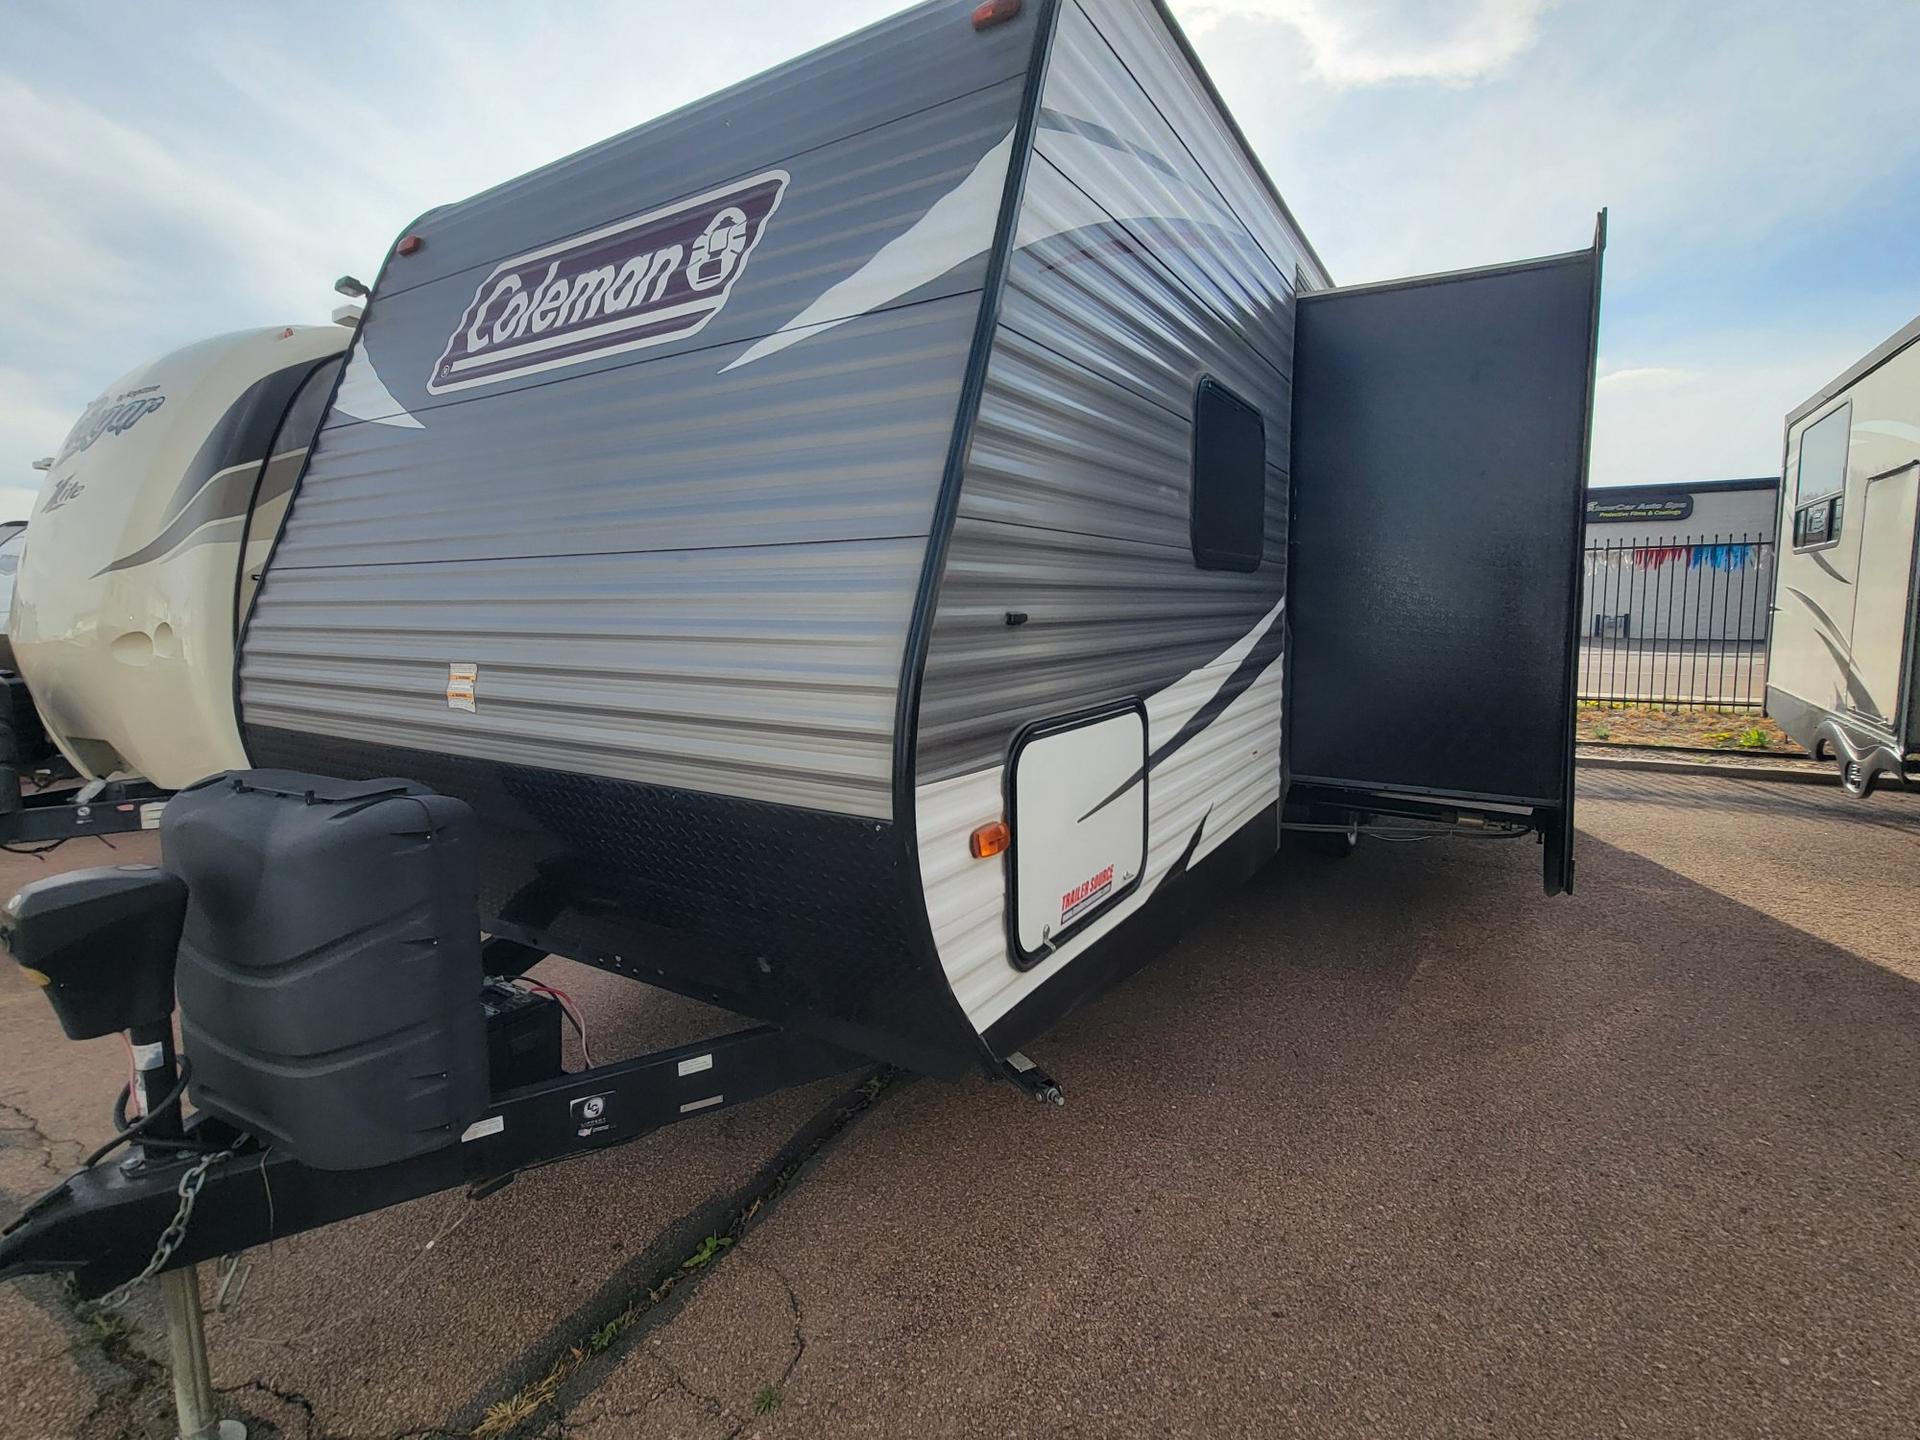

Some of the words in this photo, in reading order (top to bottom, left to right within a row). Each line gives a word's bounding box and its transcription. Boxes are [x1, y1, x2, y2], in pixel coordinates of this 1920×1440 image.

[467, 244, 683, 353] Coleman
[1637, 503, 1662, 511] Auto
[1062, 881, 1089, 911] TRAILER
[1091, 864, 1114, 892] SOURCE
